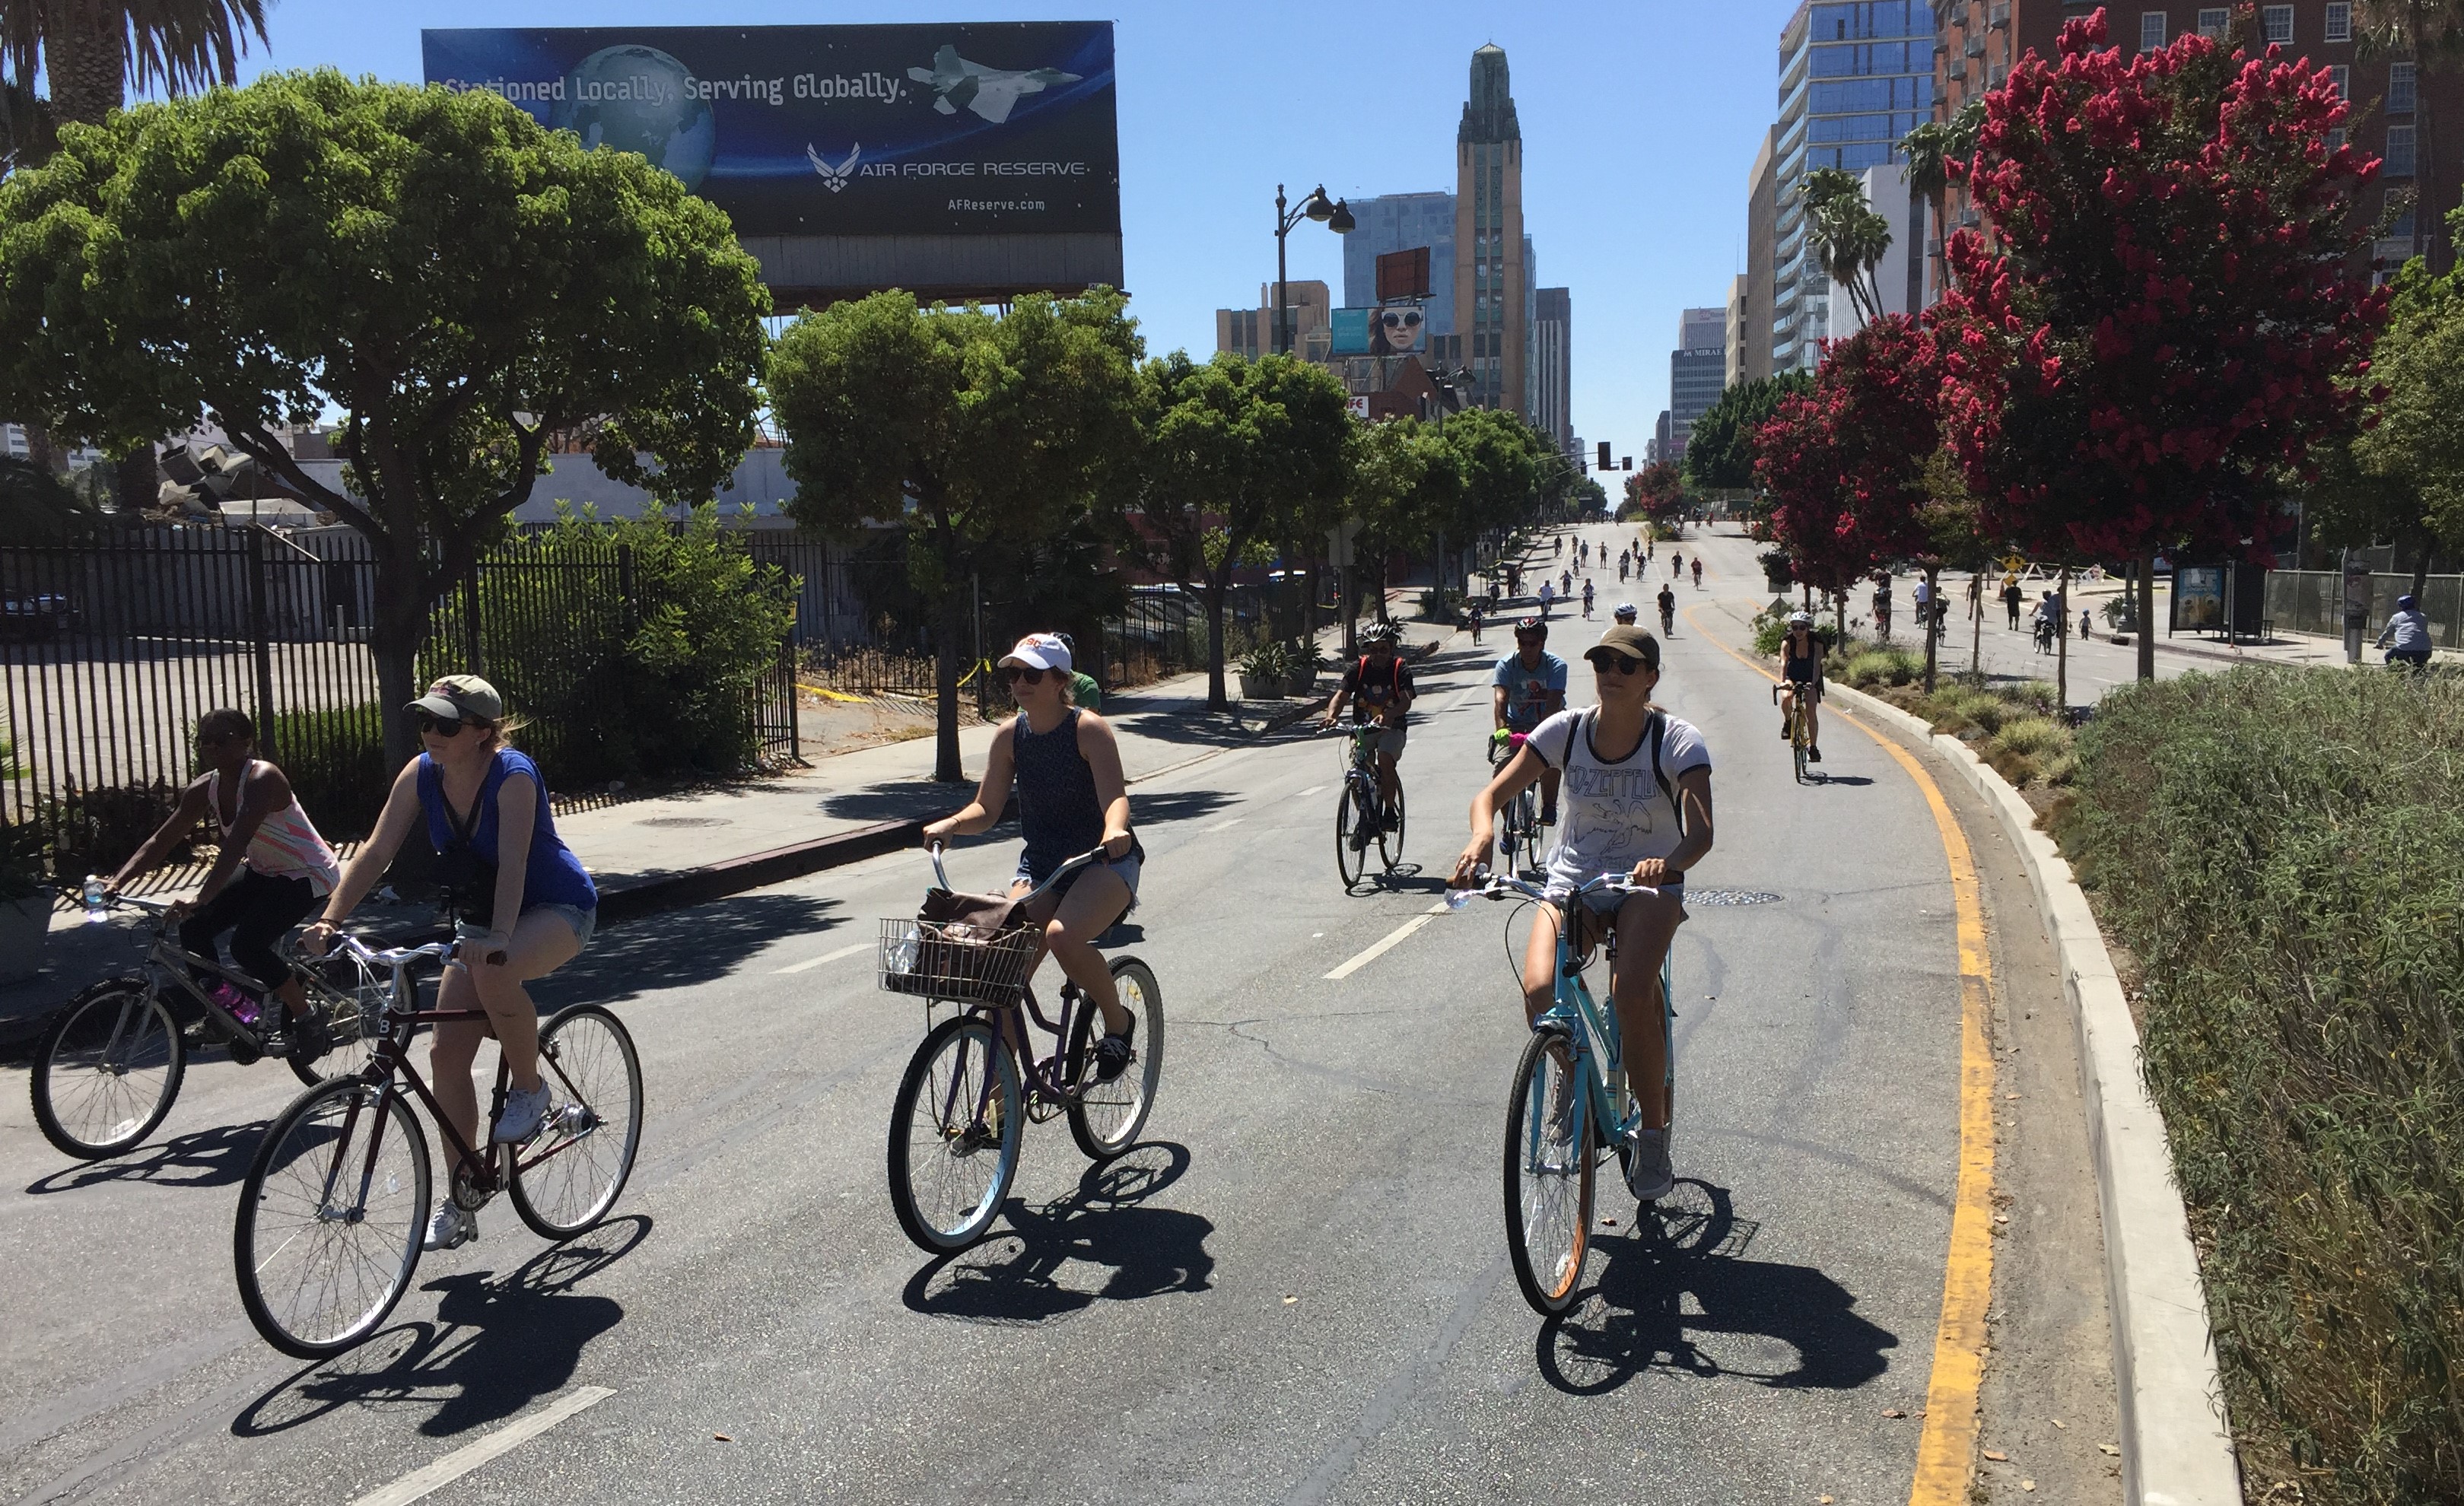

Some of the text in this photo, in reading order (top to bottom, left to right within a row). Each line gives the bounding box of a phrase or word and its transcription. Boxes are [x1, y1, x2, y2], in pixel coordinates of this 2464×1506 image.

[577, 77, 675, 106] Locally,
[684, 75, 784, 106] Serving
[793, 73, 907, 103] Globally.
[860, 162, 1085, 176] AIR FORCE RESERVE
[948, 199, 1045, 211] AFReserve.com
[380, 1020, 390, 1033] B
